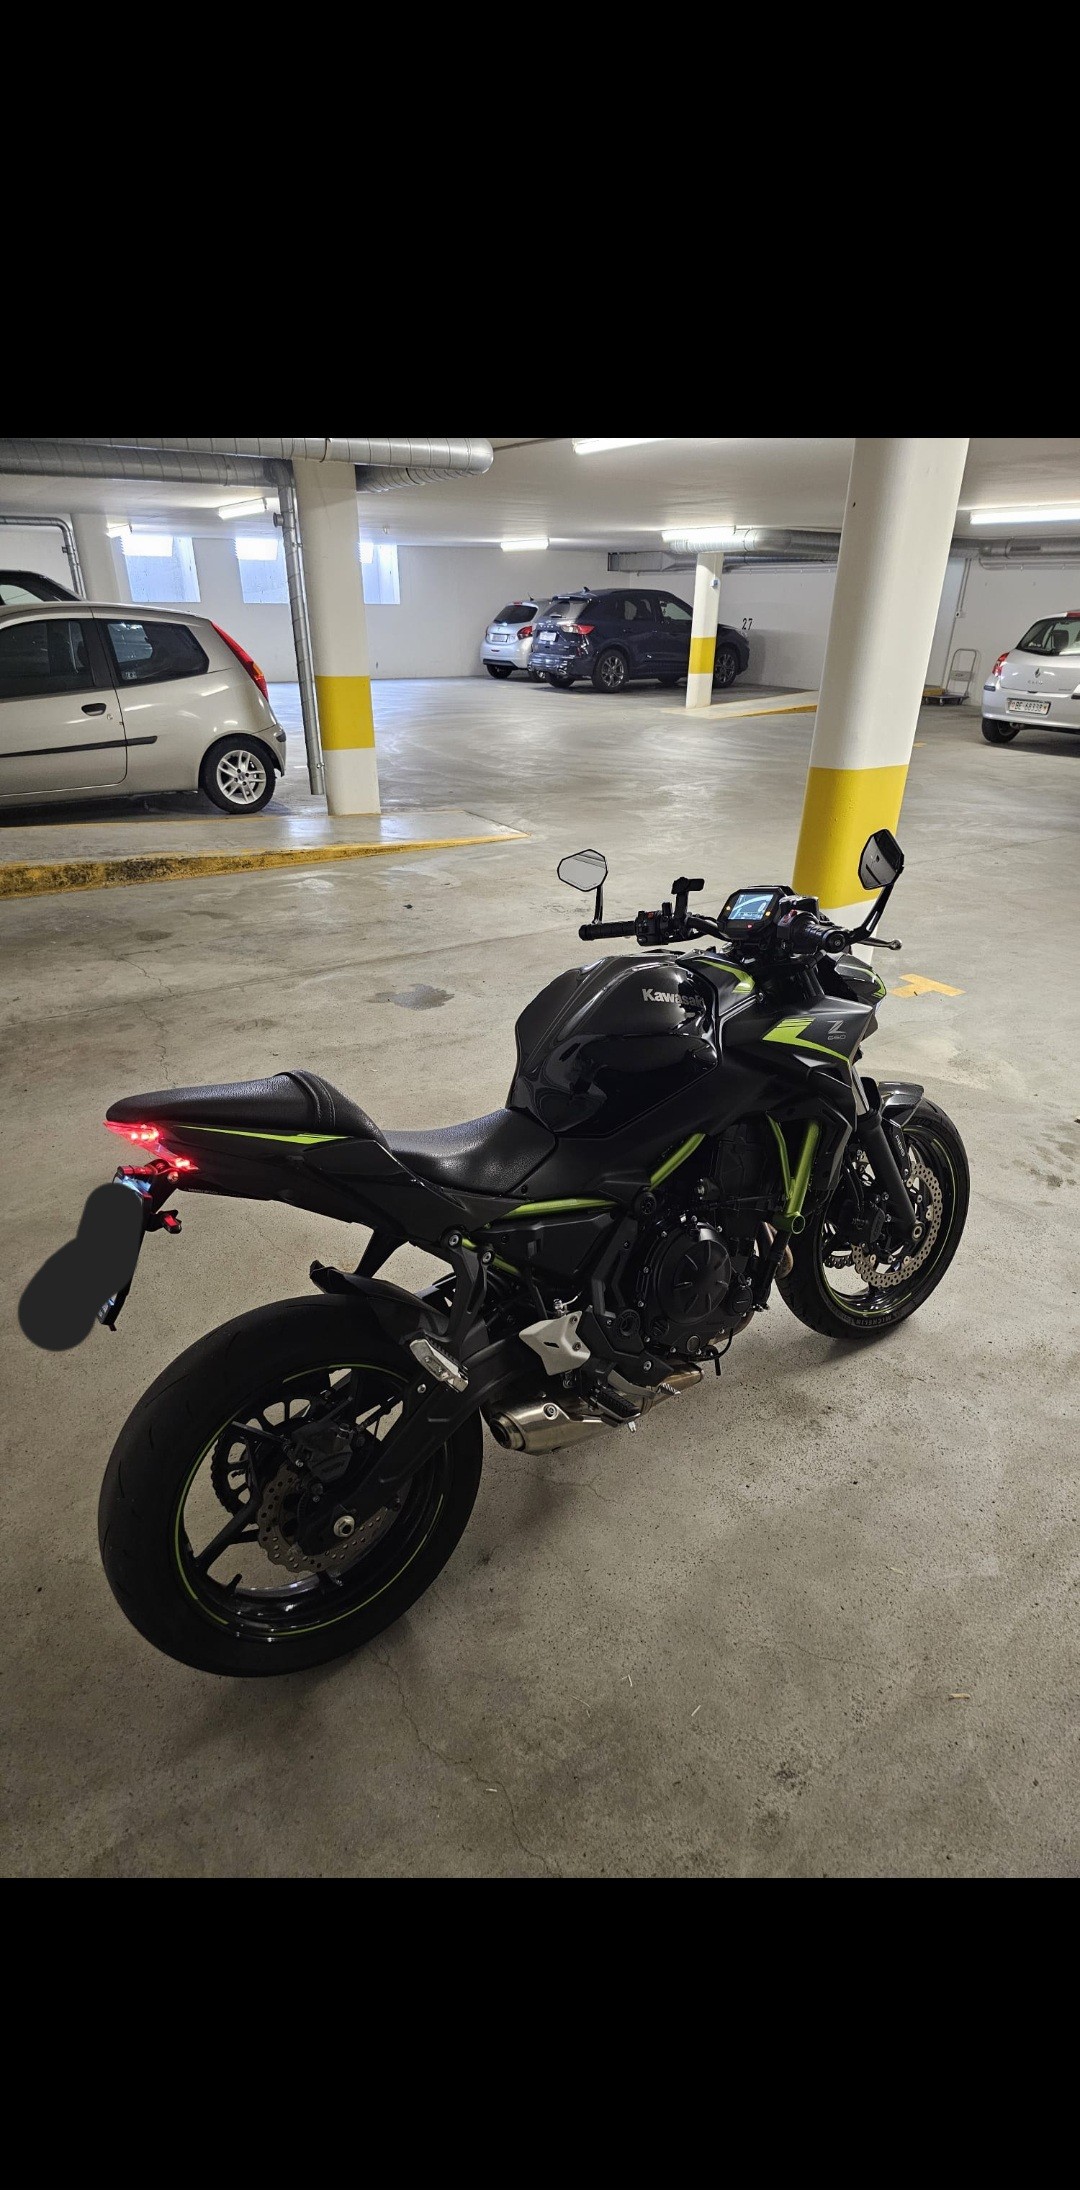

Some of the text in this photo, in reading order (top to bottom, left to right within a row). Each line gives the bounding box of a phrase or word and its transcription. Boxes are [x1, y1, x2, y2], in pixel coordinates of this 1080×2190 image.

[742, 618, 753, 630] 27
[827, 1020, 846, 1034] Z
[857, 1315, 892, 1326] MICHELIN
